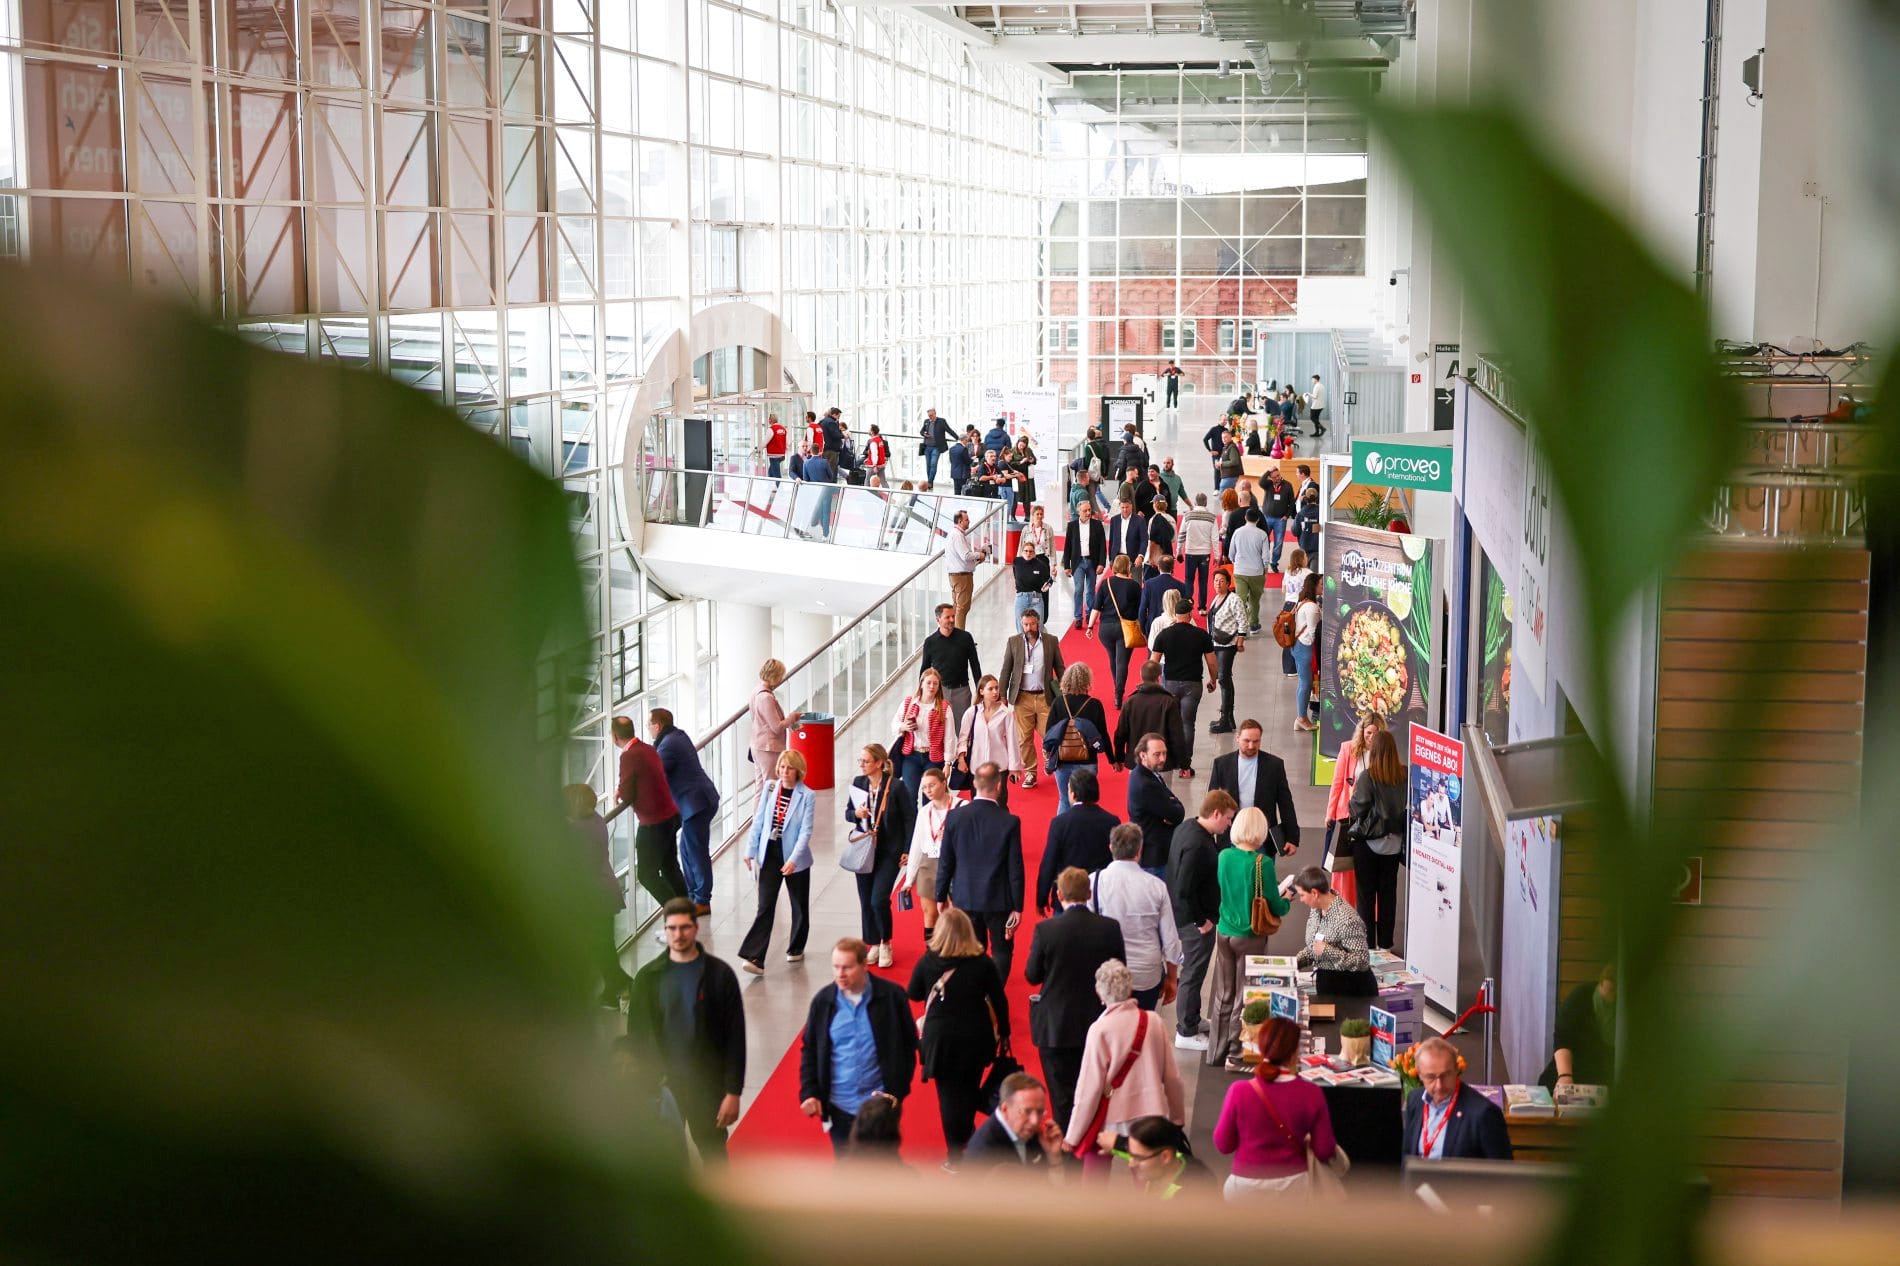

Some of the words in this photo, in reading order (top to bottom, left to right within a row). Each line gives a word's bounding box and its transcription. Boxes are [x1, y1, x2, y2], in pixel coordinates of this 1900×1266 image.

[1384, 456, 1440, 480] proveg
[1388, 471, 1426, 482] international
[1341, 554, 1412, 576] KOMPETENZZENTRUM
[1388, 577, 1412, 592] KÜCHE
[1416, 744, 1442, 764] EIGENES
[1442, 756, 1458, 772] ABO!
